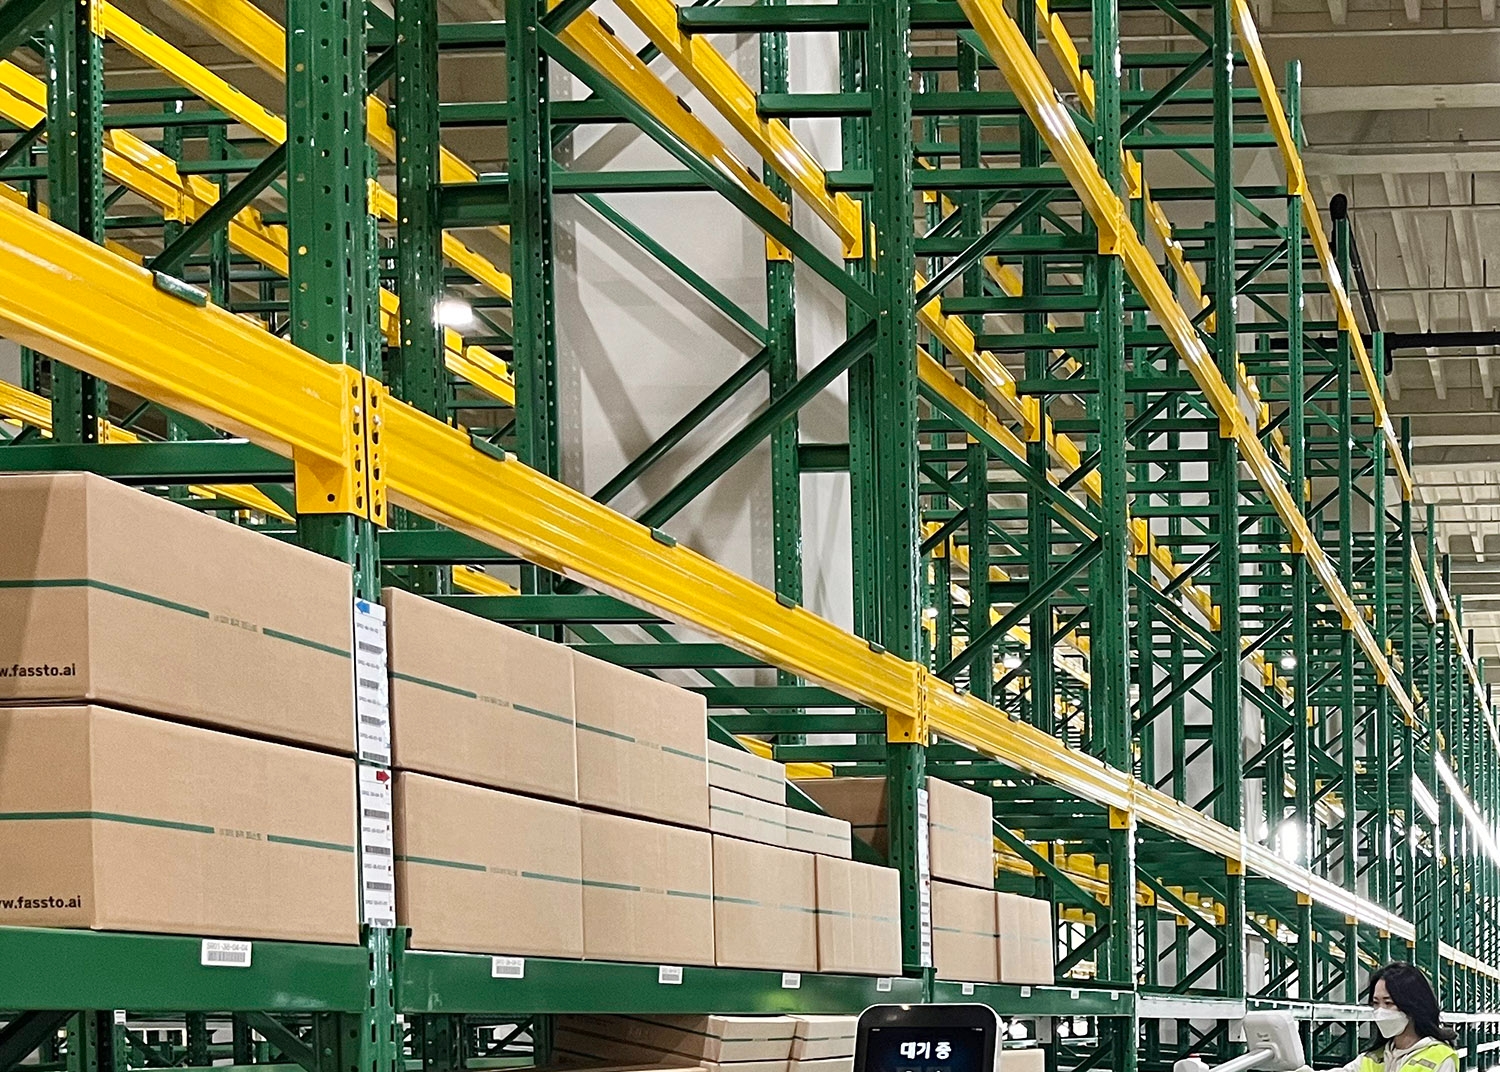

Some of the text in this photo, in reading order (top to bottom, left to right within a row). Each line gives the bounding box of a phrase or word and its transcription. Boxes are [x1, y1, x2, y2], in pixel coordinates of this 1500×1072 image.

[0, 895, 82, 909] w.fassto.ai
[900, 1041, 952, 1060] 대기 중
